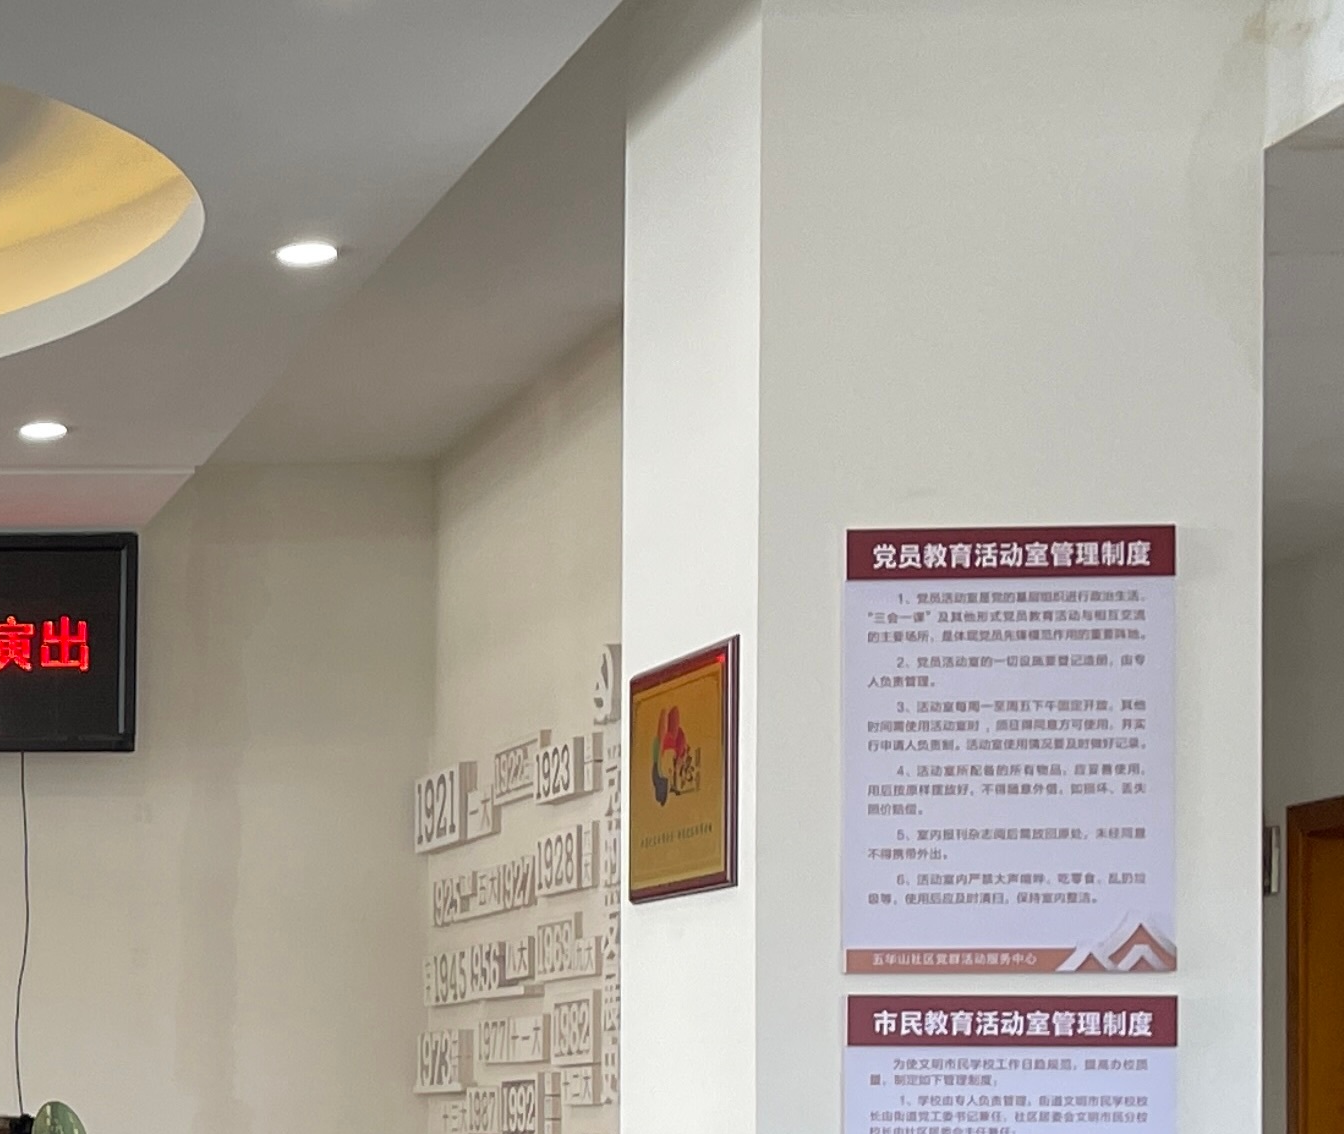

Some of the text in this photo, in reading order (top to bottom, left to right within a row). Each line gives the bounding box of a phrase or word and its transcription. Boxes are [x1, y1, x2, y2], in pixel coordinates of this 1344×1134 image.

[872, 541, 1151, 569] 党员教育活动室管理制度
[866, 675, 937, 689] 人负责管理。
[536, 744, 570, 799] 1923
[417, 771, 456, 845] 1921
[537, 832, 574, 891] 1928
[433, 951, 467, 1003] 1945
[478, 1020, 507, 1062] 1977
[873, 1010, 1154, 1037] 市民教育活动室管理制度
[502, 1085, 536, 1134] 1992
